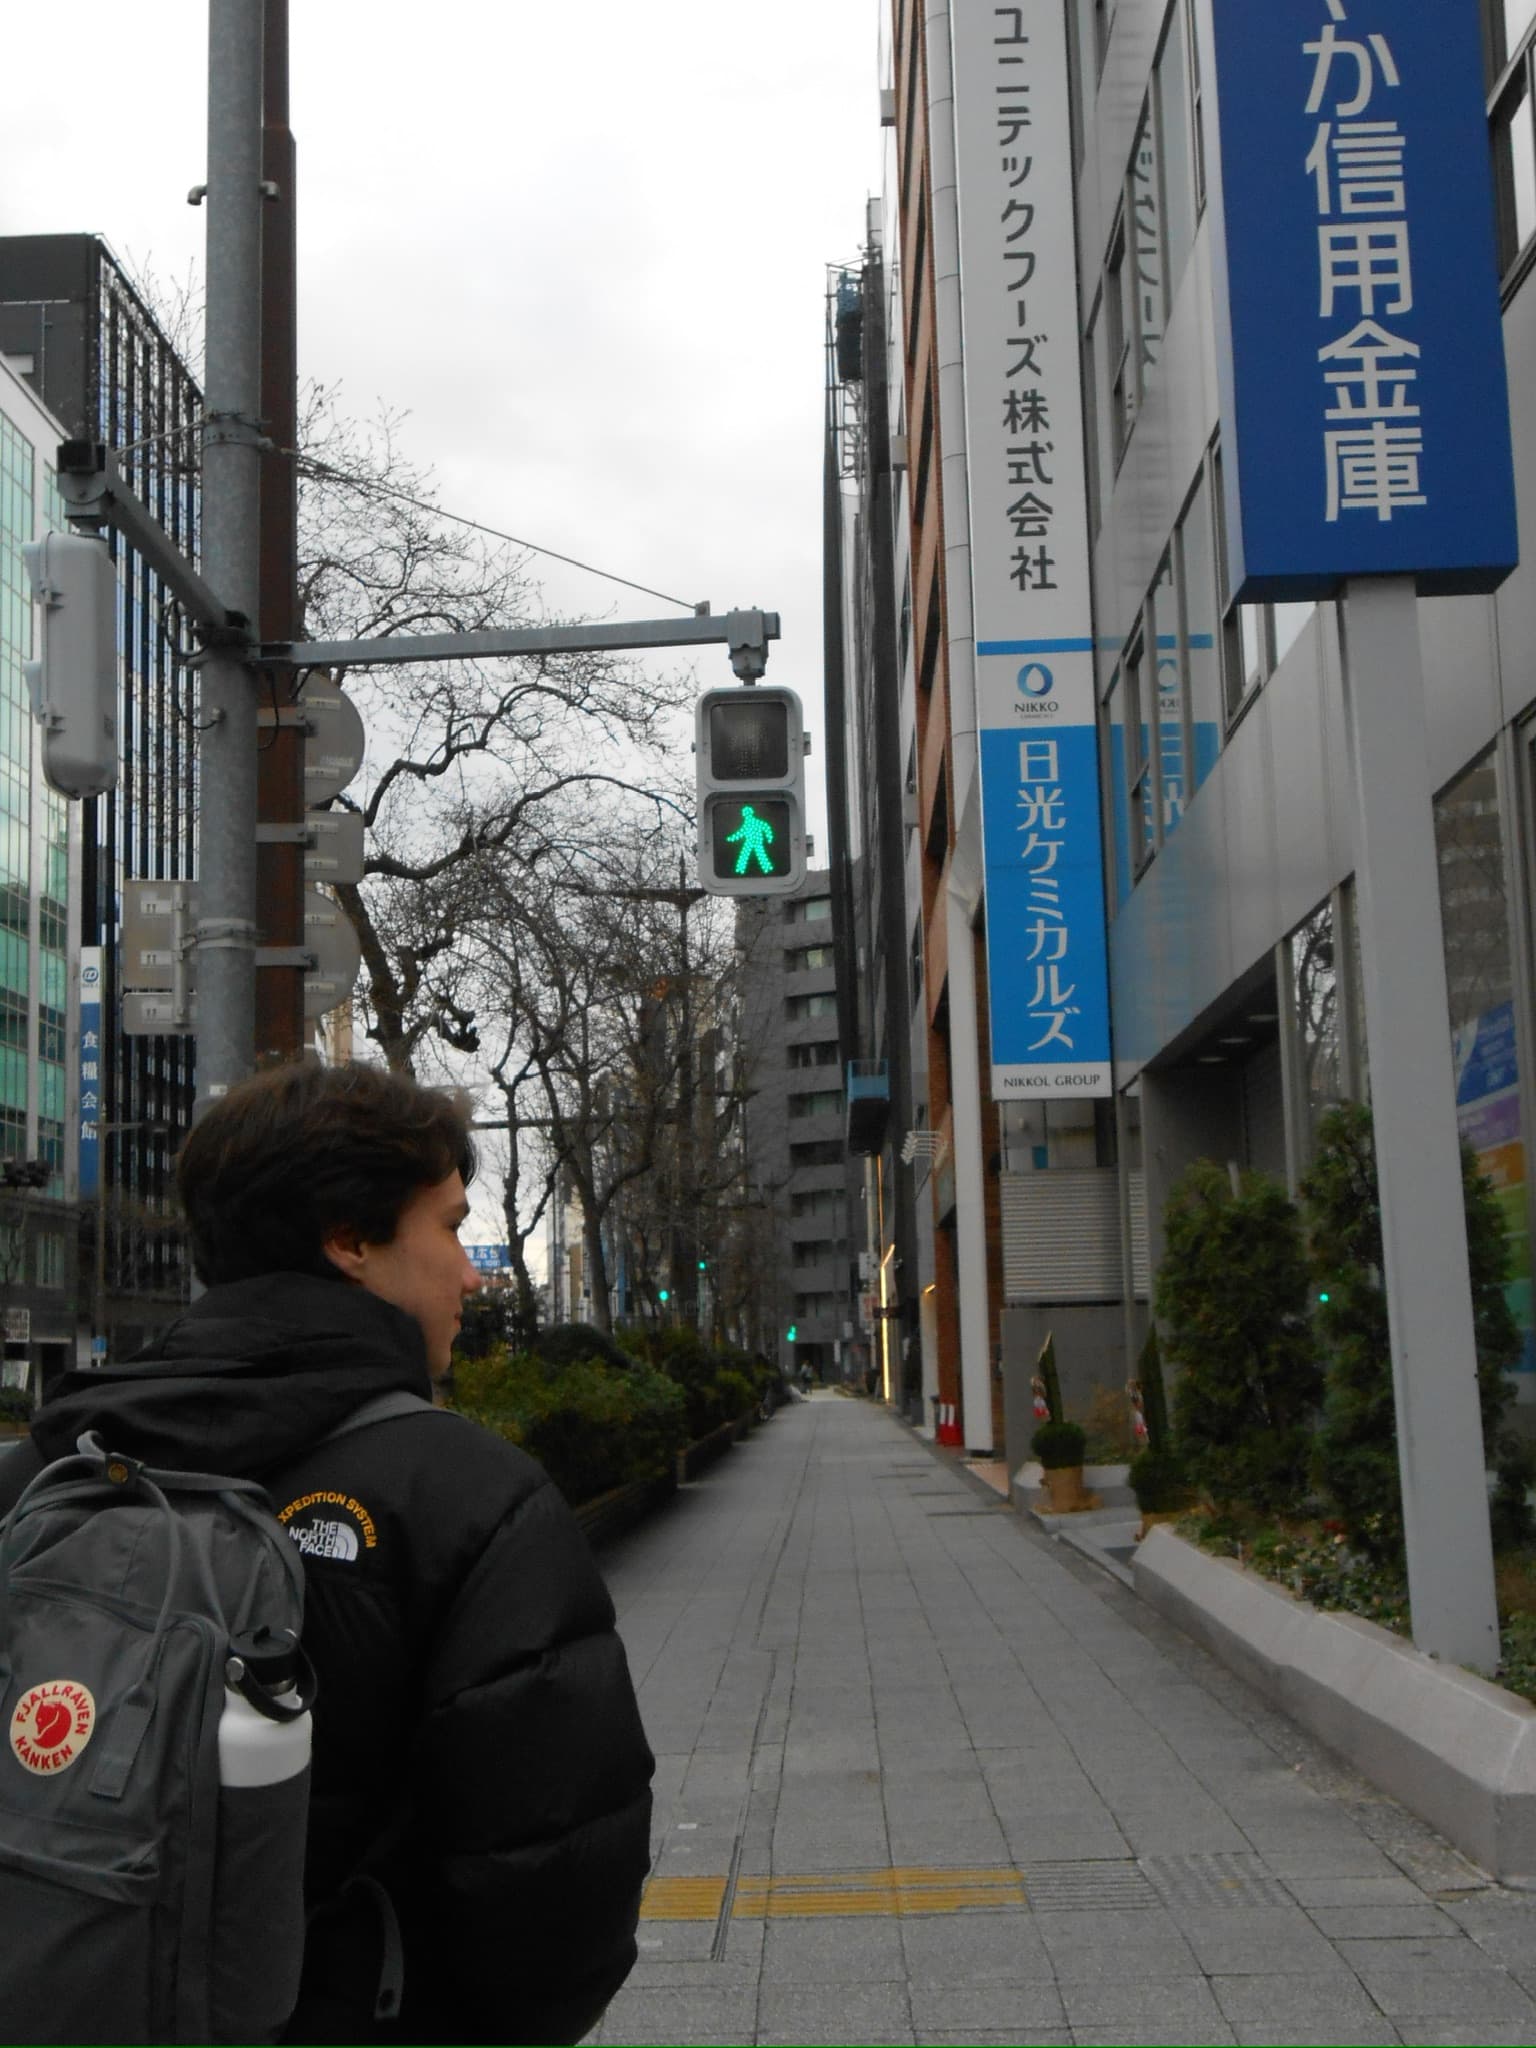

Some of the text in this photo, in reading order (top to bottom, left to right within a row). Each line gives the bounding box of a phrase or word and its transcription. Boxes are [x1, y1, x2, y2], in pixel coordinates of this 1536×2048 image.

[993, 7, 1058, 592] ユニテックフーズ株式会社
[1014, 701, 1059, 712] NIKKO
[1015, 740, 1081, 1052] 日光ケミカルズ
[1003, 1073, 1101, 1088] NIKKOL GROUP
[277, 1491, 378, 1548] XPEDITION SYSTEM
[312, 1518, 338, 1535] THE
[288, 1526, 336, 1547] NORTH
[299, 1540, 334, 1558] FACE
